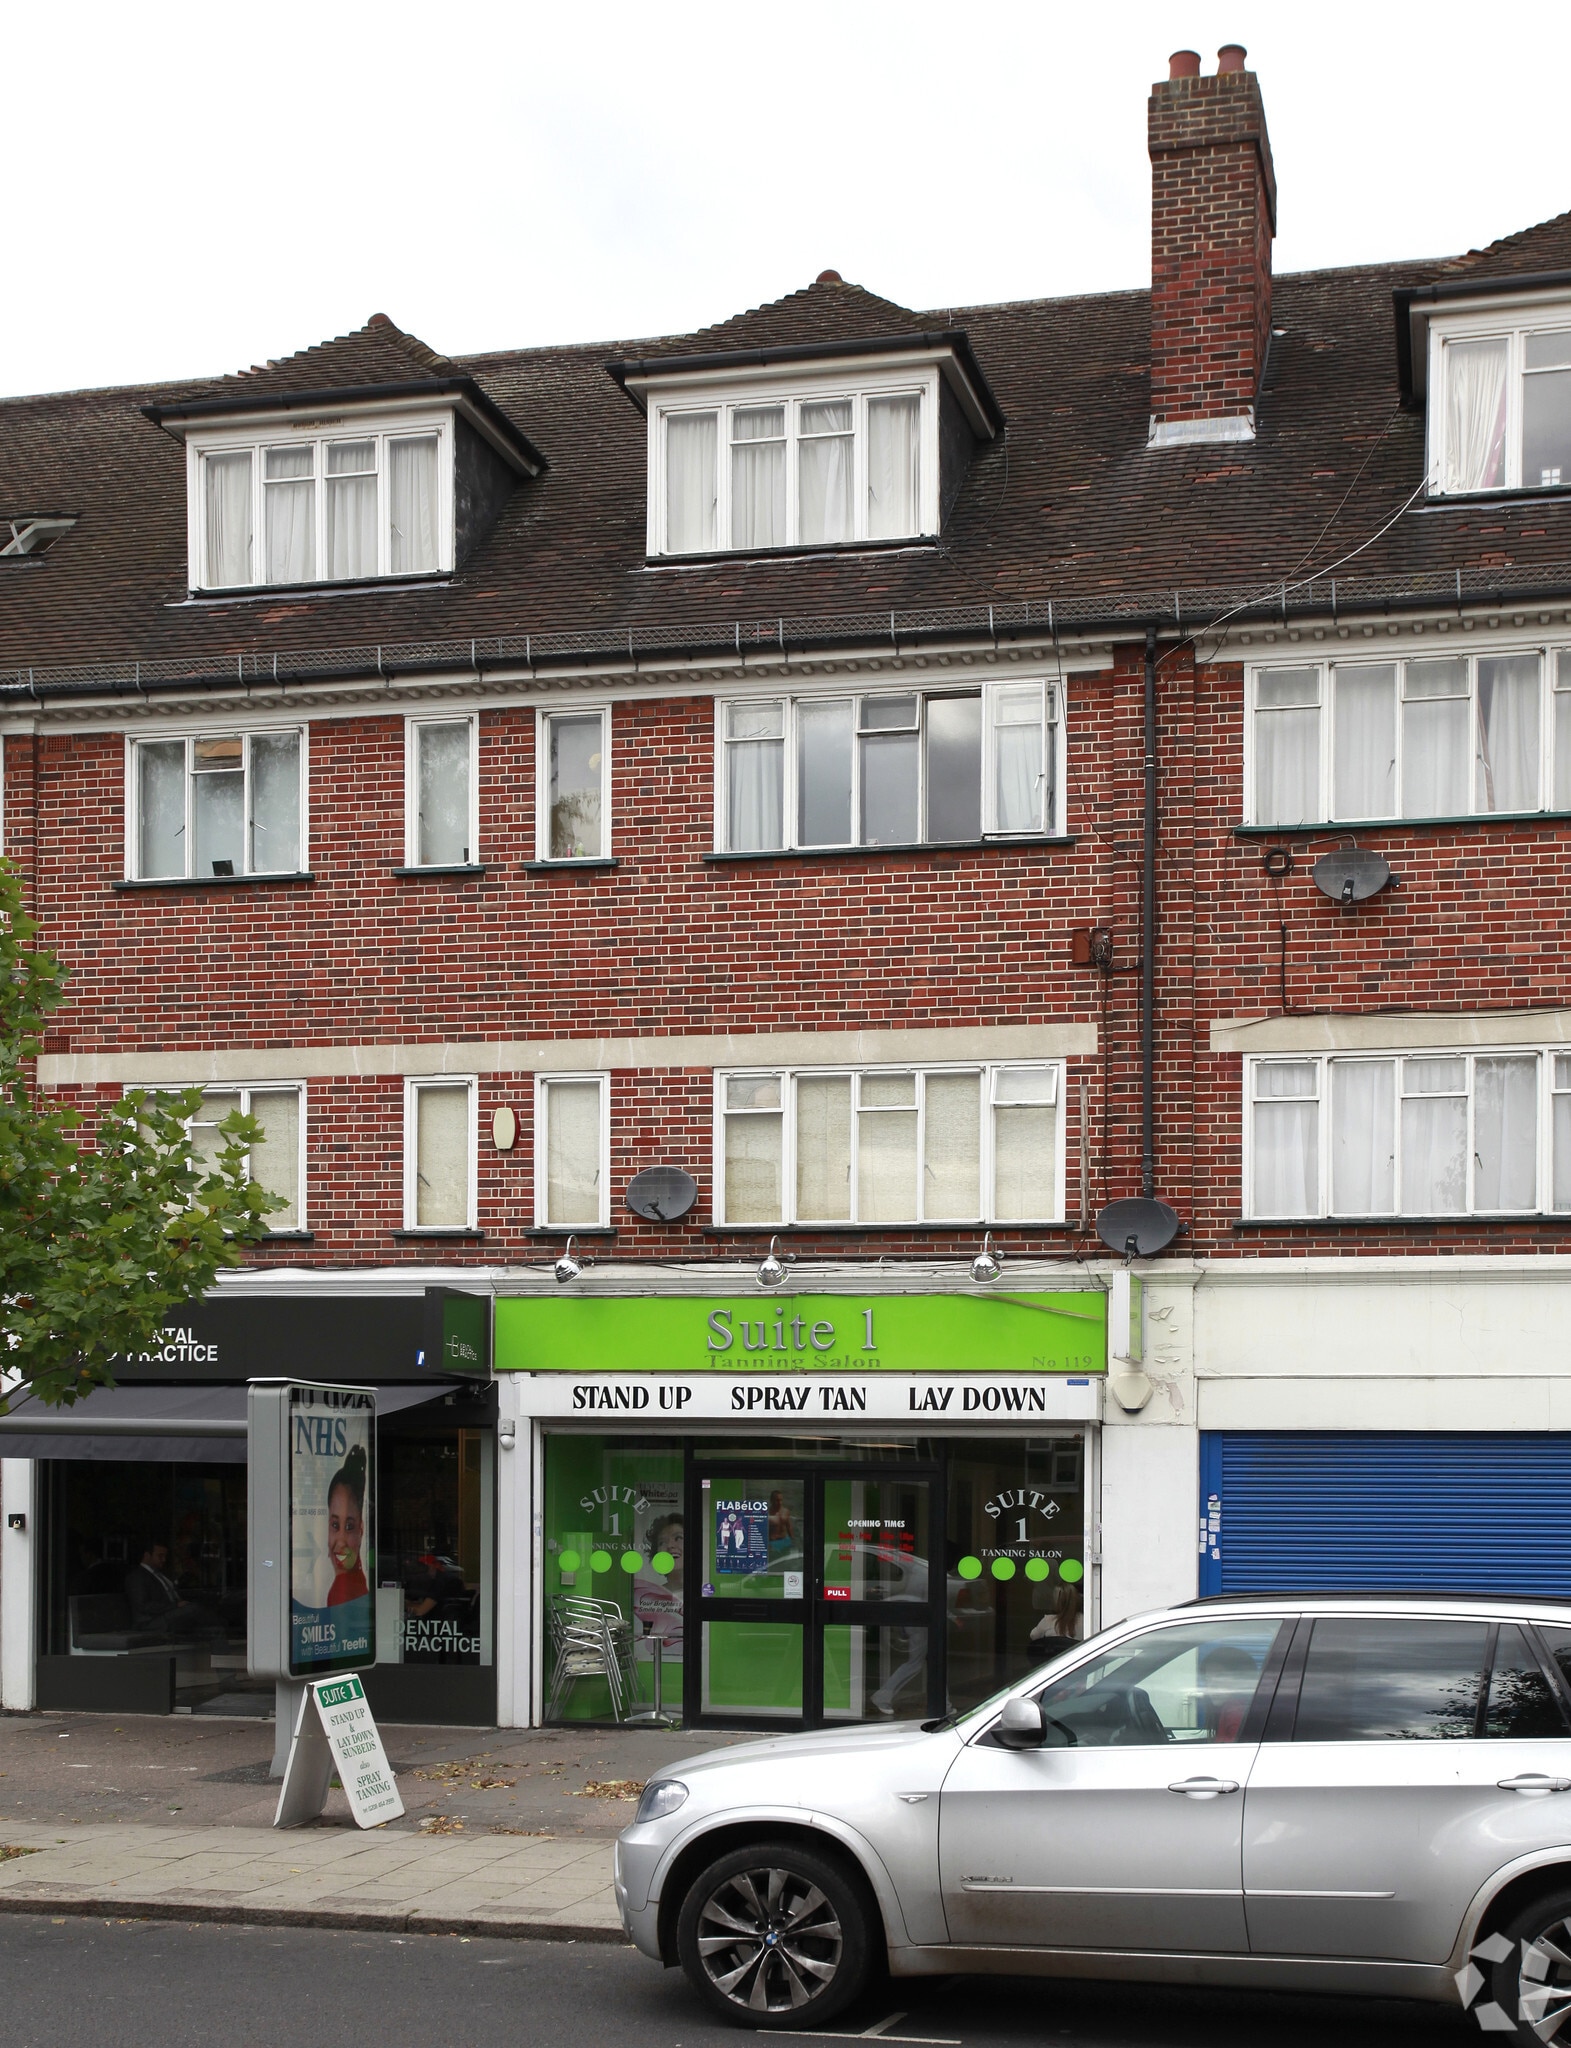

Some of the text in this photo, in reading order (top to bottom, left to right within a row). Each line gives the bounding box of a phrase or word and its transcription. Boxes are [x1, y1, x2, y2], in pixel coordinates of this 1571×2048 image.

[708, 1307, 836, 1351] Suite
[704, 1354, 881, 1372] Tanning Salon
[1032, 1355, 1092, 1368] No 119
[572, 1385, 692, 1409] STAND UP
[731, 1386, 866, 1410] SPRAY TAN
[909, 1387, 1046, 1411] LAY DOWN
[295, 1415, 347, 1457] NHS
[580, 1485, 651, 1515] SUITE
[716, 1500, 768, 1511] FLABéLOS
[984, 1489, 1060, 1520] SUITE
[609, 1512, 622, 1536] 1
[847, 1520, 905, 1528] OPENING TIMES
[1015, 1517, 1030, 1542] 1
[981, 1549, 1062, 1558] TANNING SALON
[301, 1624, 336, 1644] SMILES
[393, 1620, 463, 1636] DENTAL
[342, 1637, 368, 1651] Teeth
[393, 1636, 480, 1653] PRACTICE
[322, 1681, 360, 1705] SUITE 1
[330, 1708, 365, 1726] STAND UP
[349, 1723, 355, 1733] &
[336, 1729, 375, 1749] LAY DOWN
[342, 1741, 377, 1759] SUNBEDS
[356, 1770, 381, 1788] SPRAY
[356, 1781, 391, 1801] TANNING
